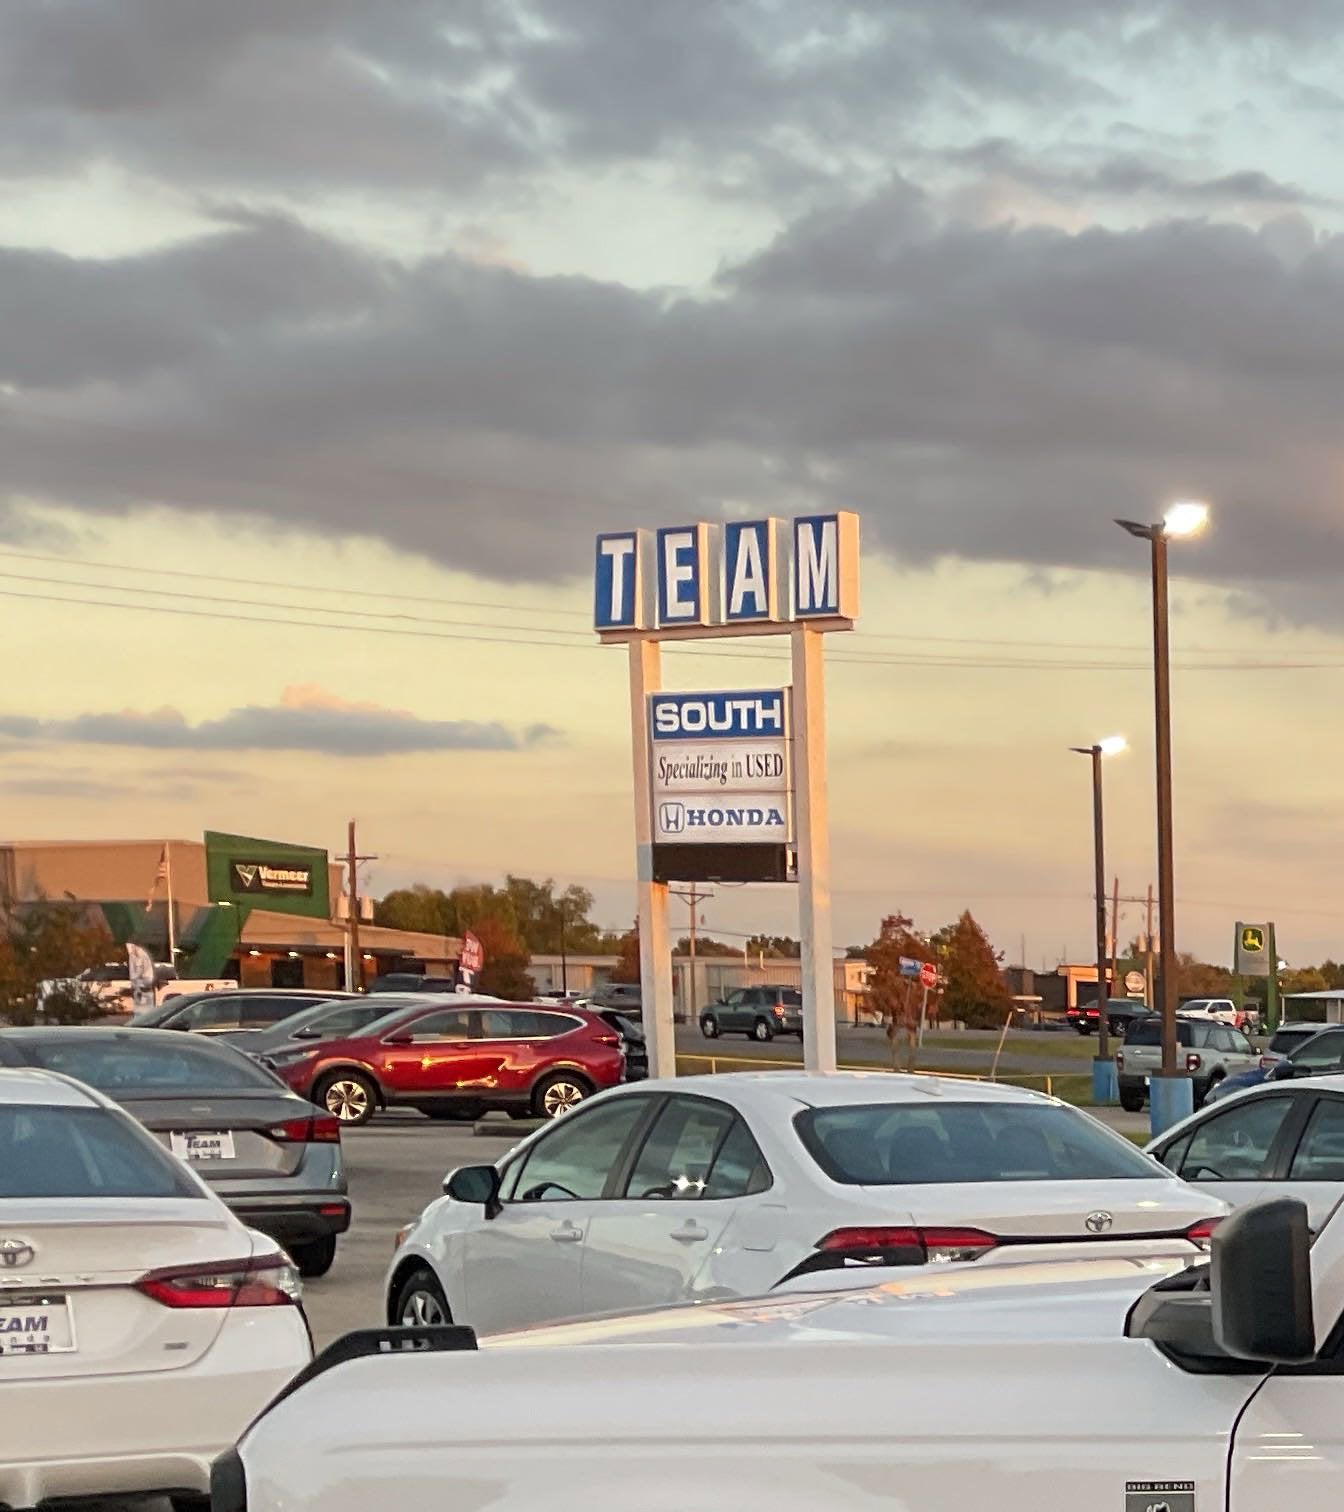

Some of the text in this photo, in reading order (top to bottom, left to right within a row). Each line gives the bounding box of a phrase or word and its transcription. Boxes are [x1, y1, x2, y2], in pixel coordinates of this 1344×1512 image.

[602, 521, 837, 621] TEAM
[656, 699, 781, 733] SOUTH
[658, 754, 783, 786] Specializing in USED
[687, 809, 784, 826] HONDA
[258, 866, 309, 882] Vermeer
[184, 1136, 221, 1149] TEAM
